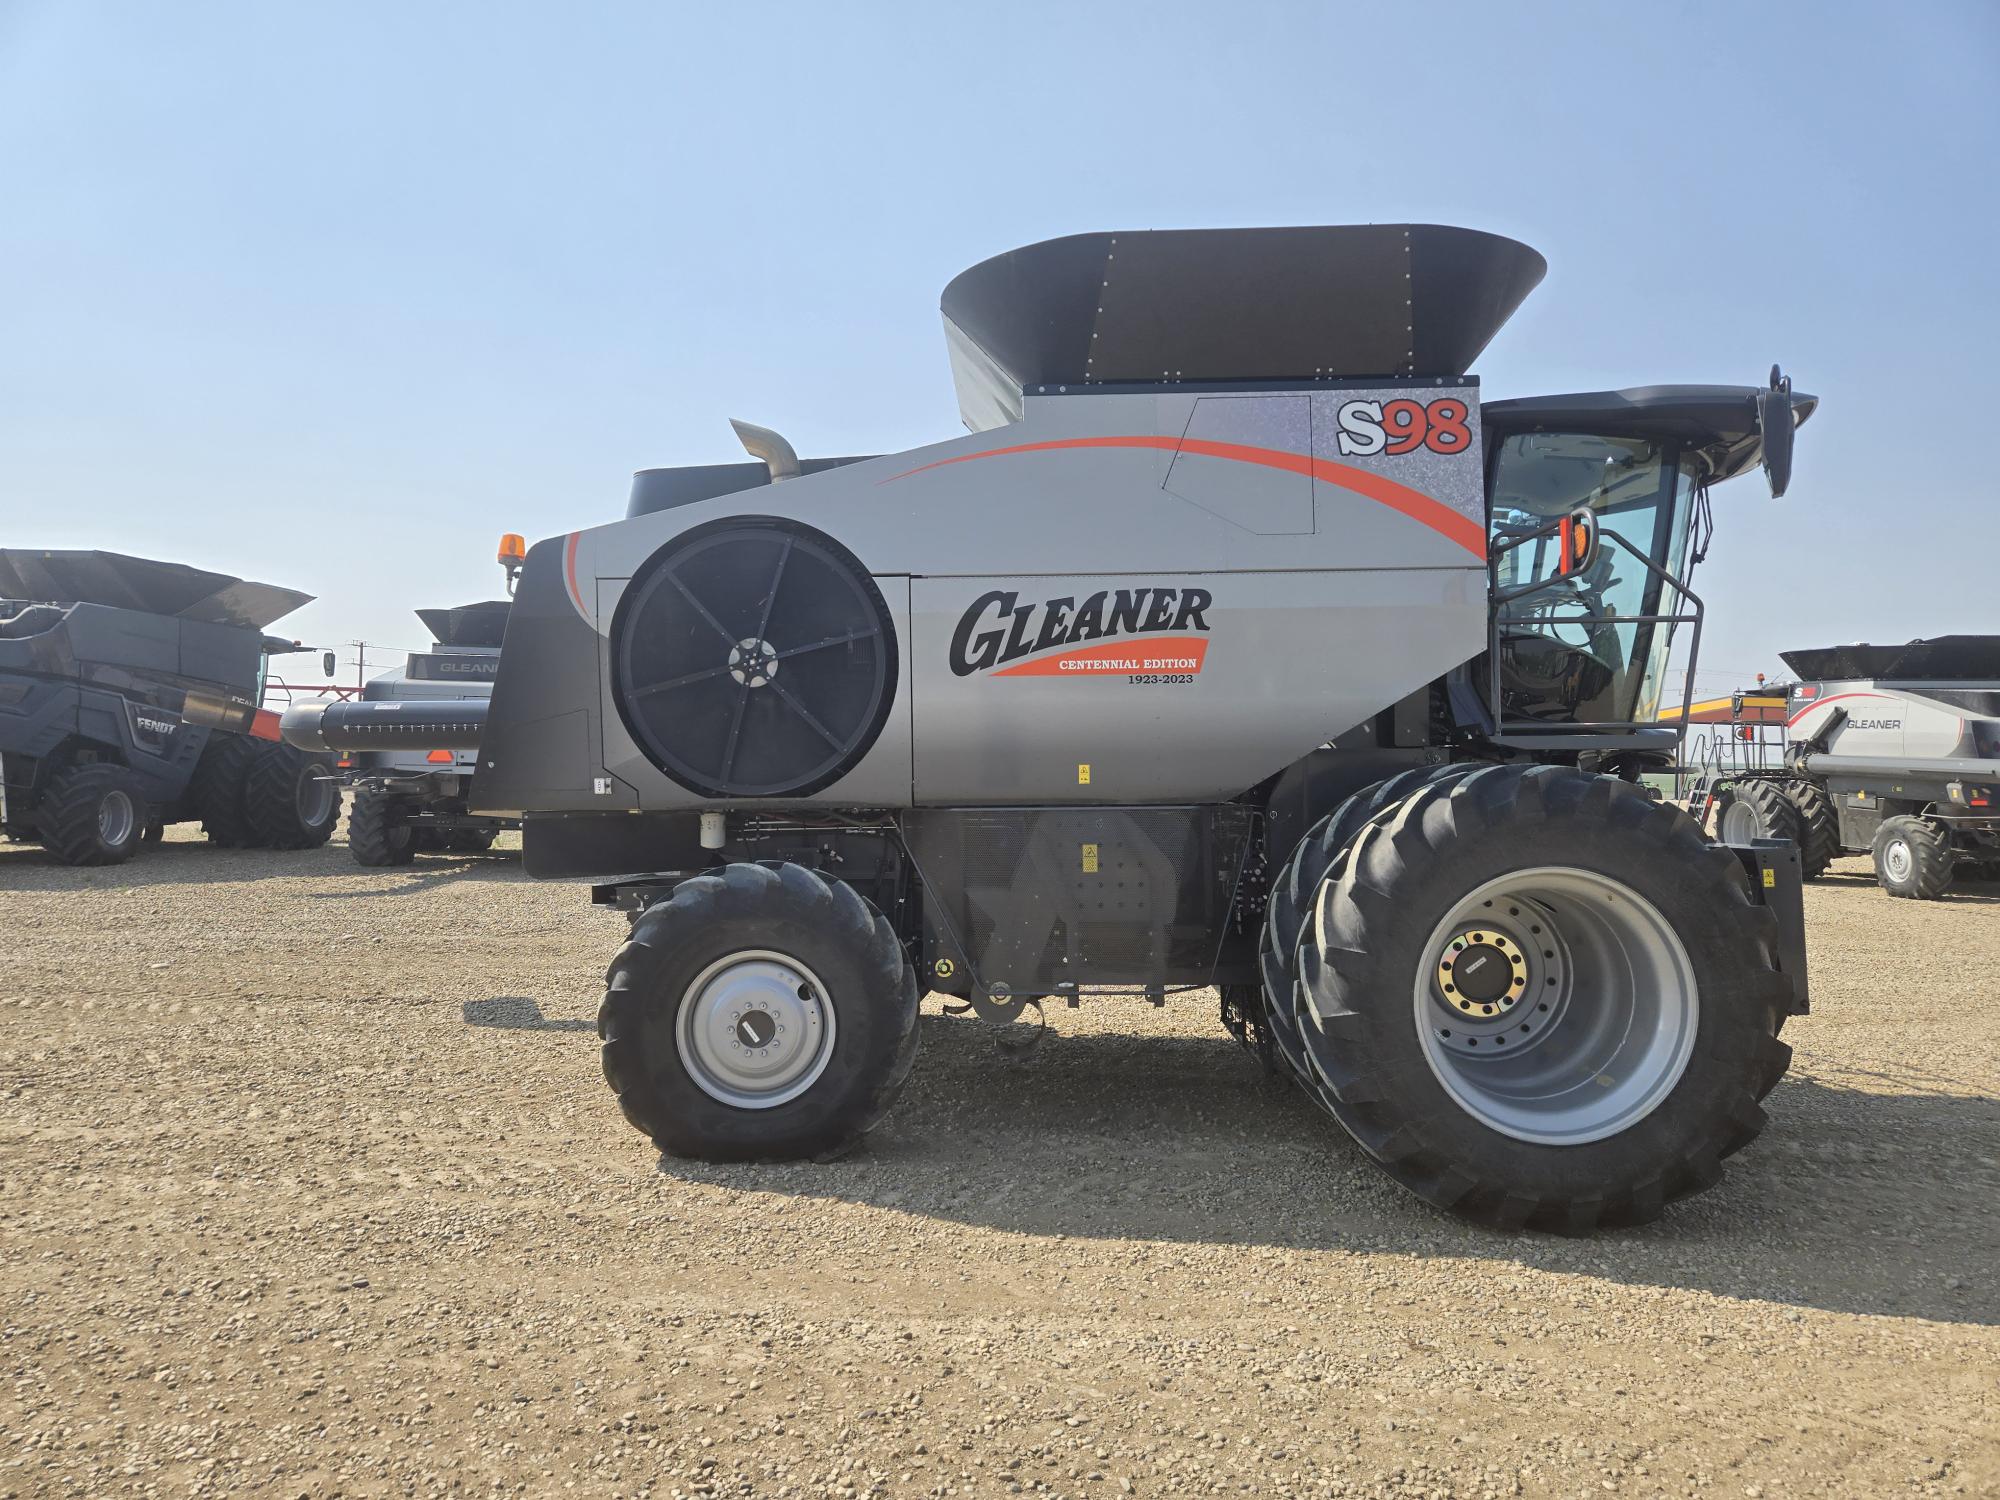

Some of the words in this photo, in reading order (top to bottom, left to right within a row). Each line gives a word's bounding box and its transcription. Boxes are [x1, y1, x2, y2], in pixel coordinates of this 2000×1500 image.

[1336, 398, 1472, 457] S98
[949, 588, 1213, 677] GLEANER
[1059, 659, 1140, 670] CENTENNIAL
[1143, 658, 1197, 669] EDITION
[1128, 674, 1194, 685] 1923-2023
[136, 716, 177, 735] FENDT
[1846, 719, 1901, 729] GLEANER
